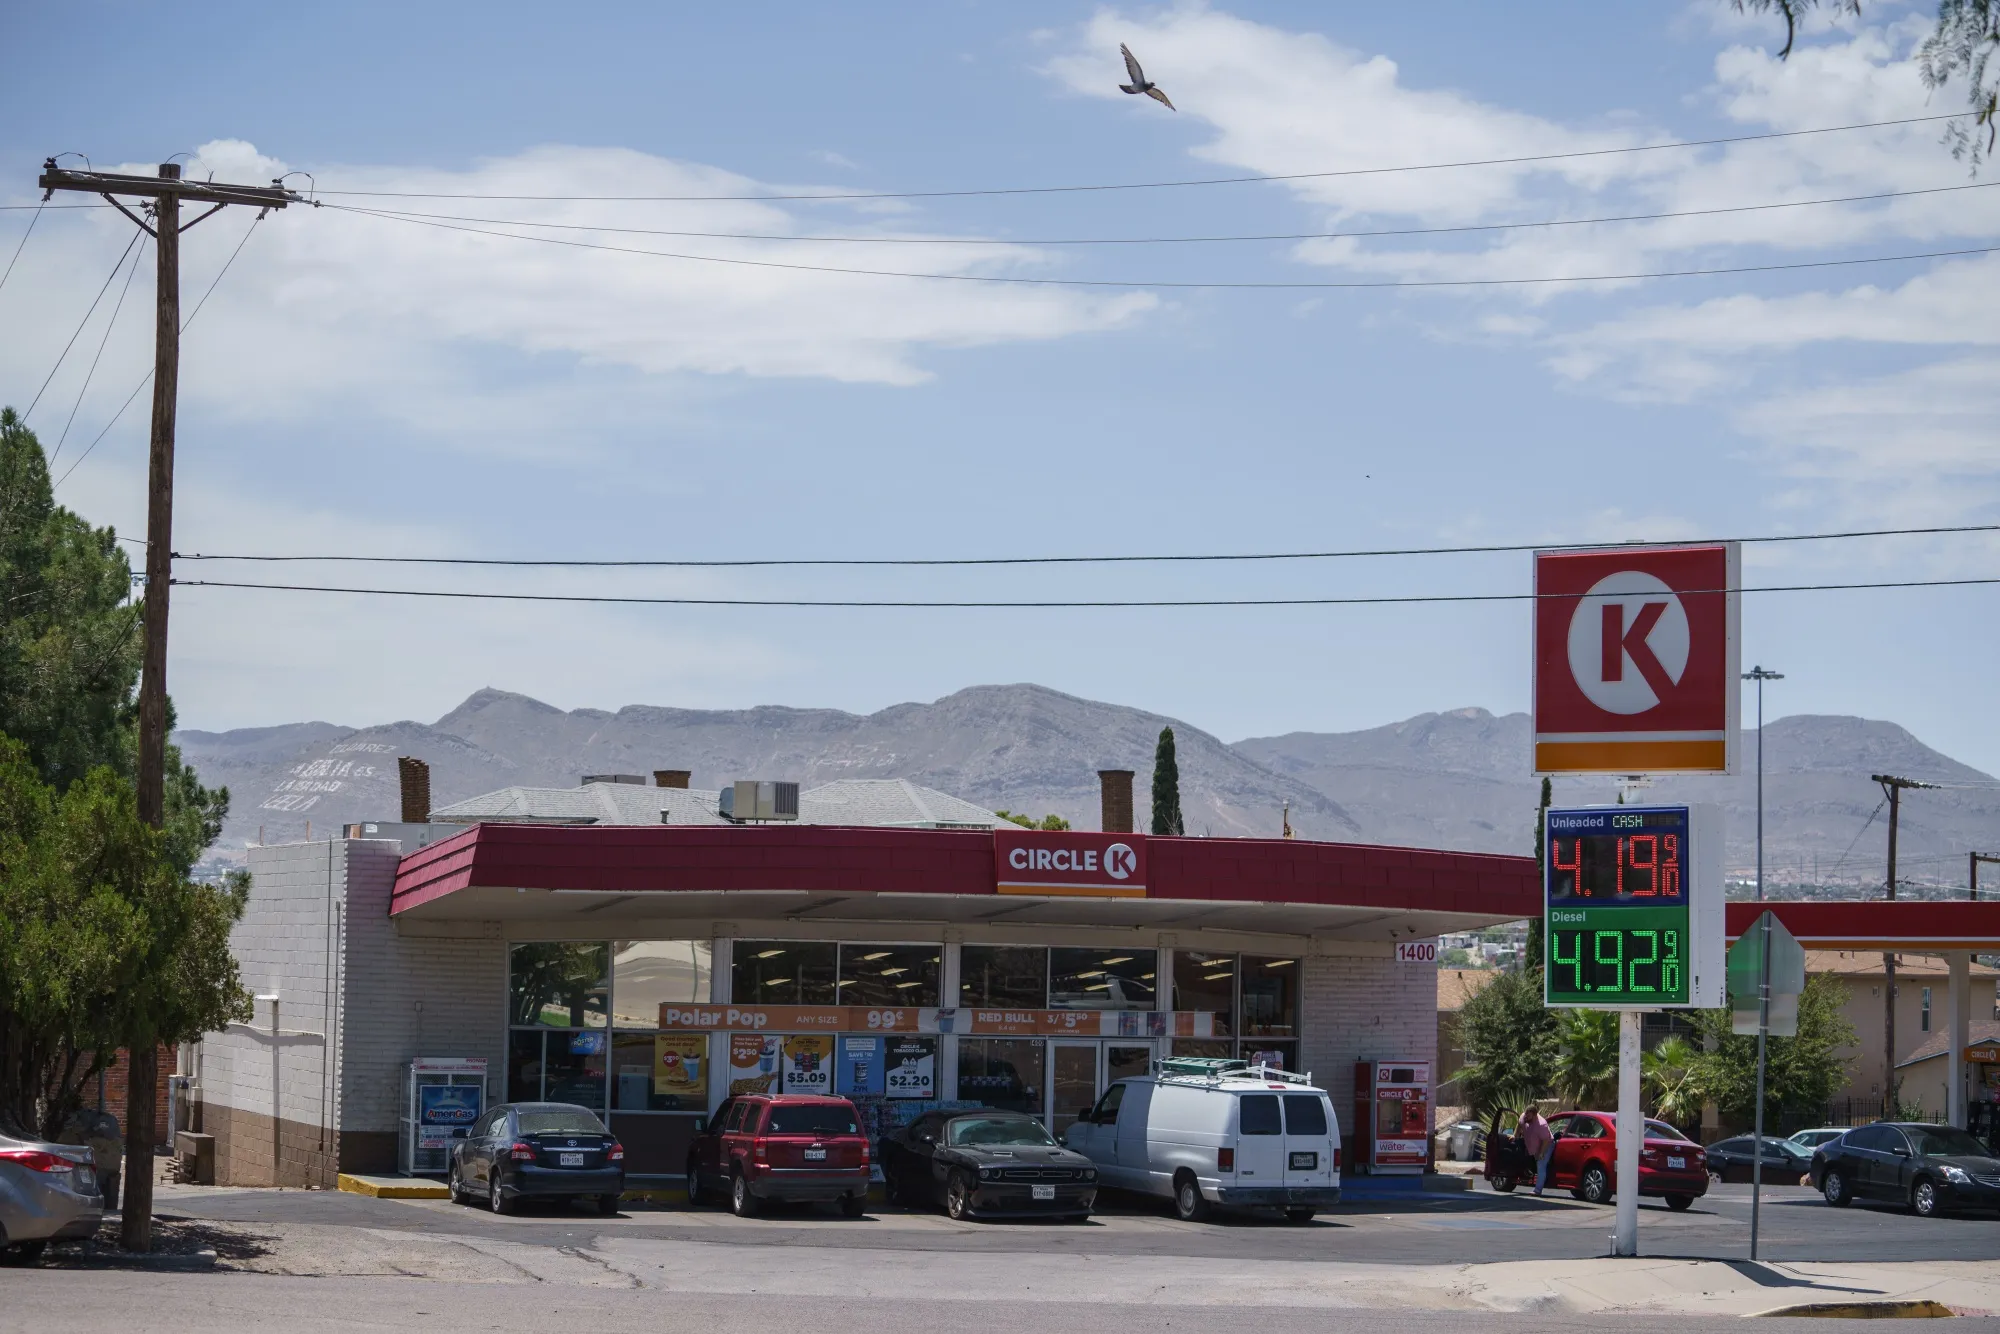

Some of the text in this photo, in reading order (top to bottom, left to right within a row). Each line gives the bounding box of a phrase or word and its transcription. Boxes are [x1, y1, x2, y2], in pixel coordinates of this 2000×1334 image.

[1592, 592, 1682, 706] K
[1551, 815, 1643, 829] Unleaded CASH
[1008, 847, 1135, 879] CIRCLE K
[1552, 911, 1586, 922] Diesel
[1399, 944, 1435, 961] 1400
[666, 1008, 722, 1027] Polar
[726, 1009, 768, 1029] Pop
[796, 1015, 815, 1025] ANY
[817, 1015, 839, 1025] SIZE
[978, 1013, 1002, 1022] RED
[1004, 1013, 1036, 1023] BULL
[1971, 1050, 1988, 1059] CIRCLE
[787, 1072, 827, 1084] $5.09
[1380, 1070, 1389, 1080] K
[889, 1075, 930, 1087] $2.20
[1403, 1089, 1412, 1099] K
[427, 1109, 473, 1119] AmeriGas
[1380, 1142, 1406, 1151] water
